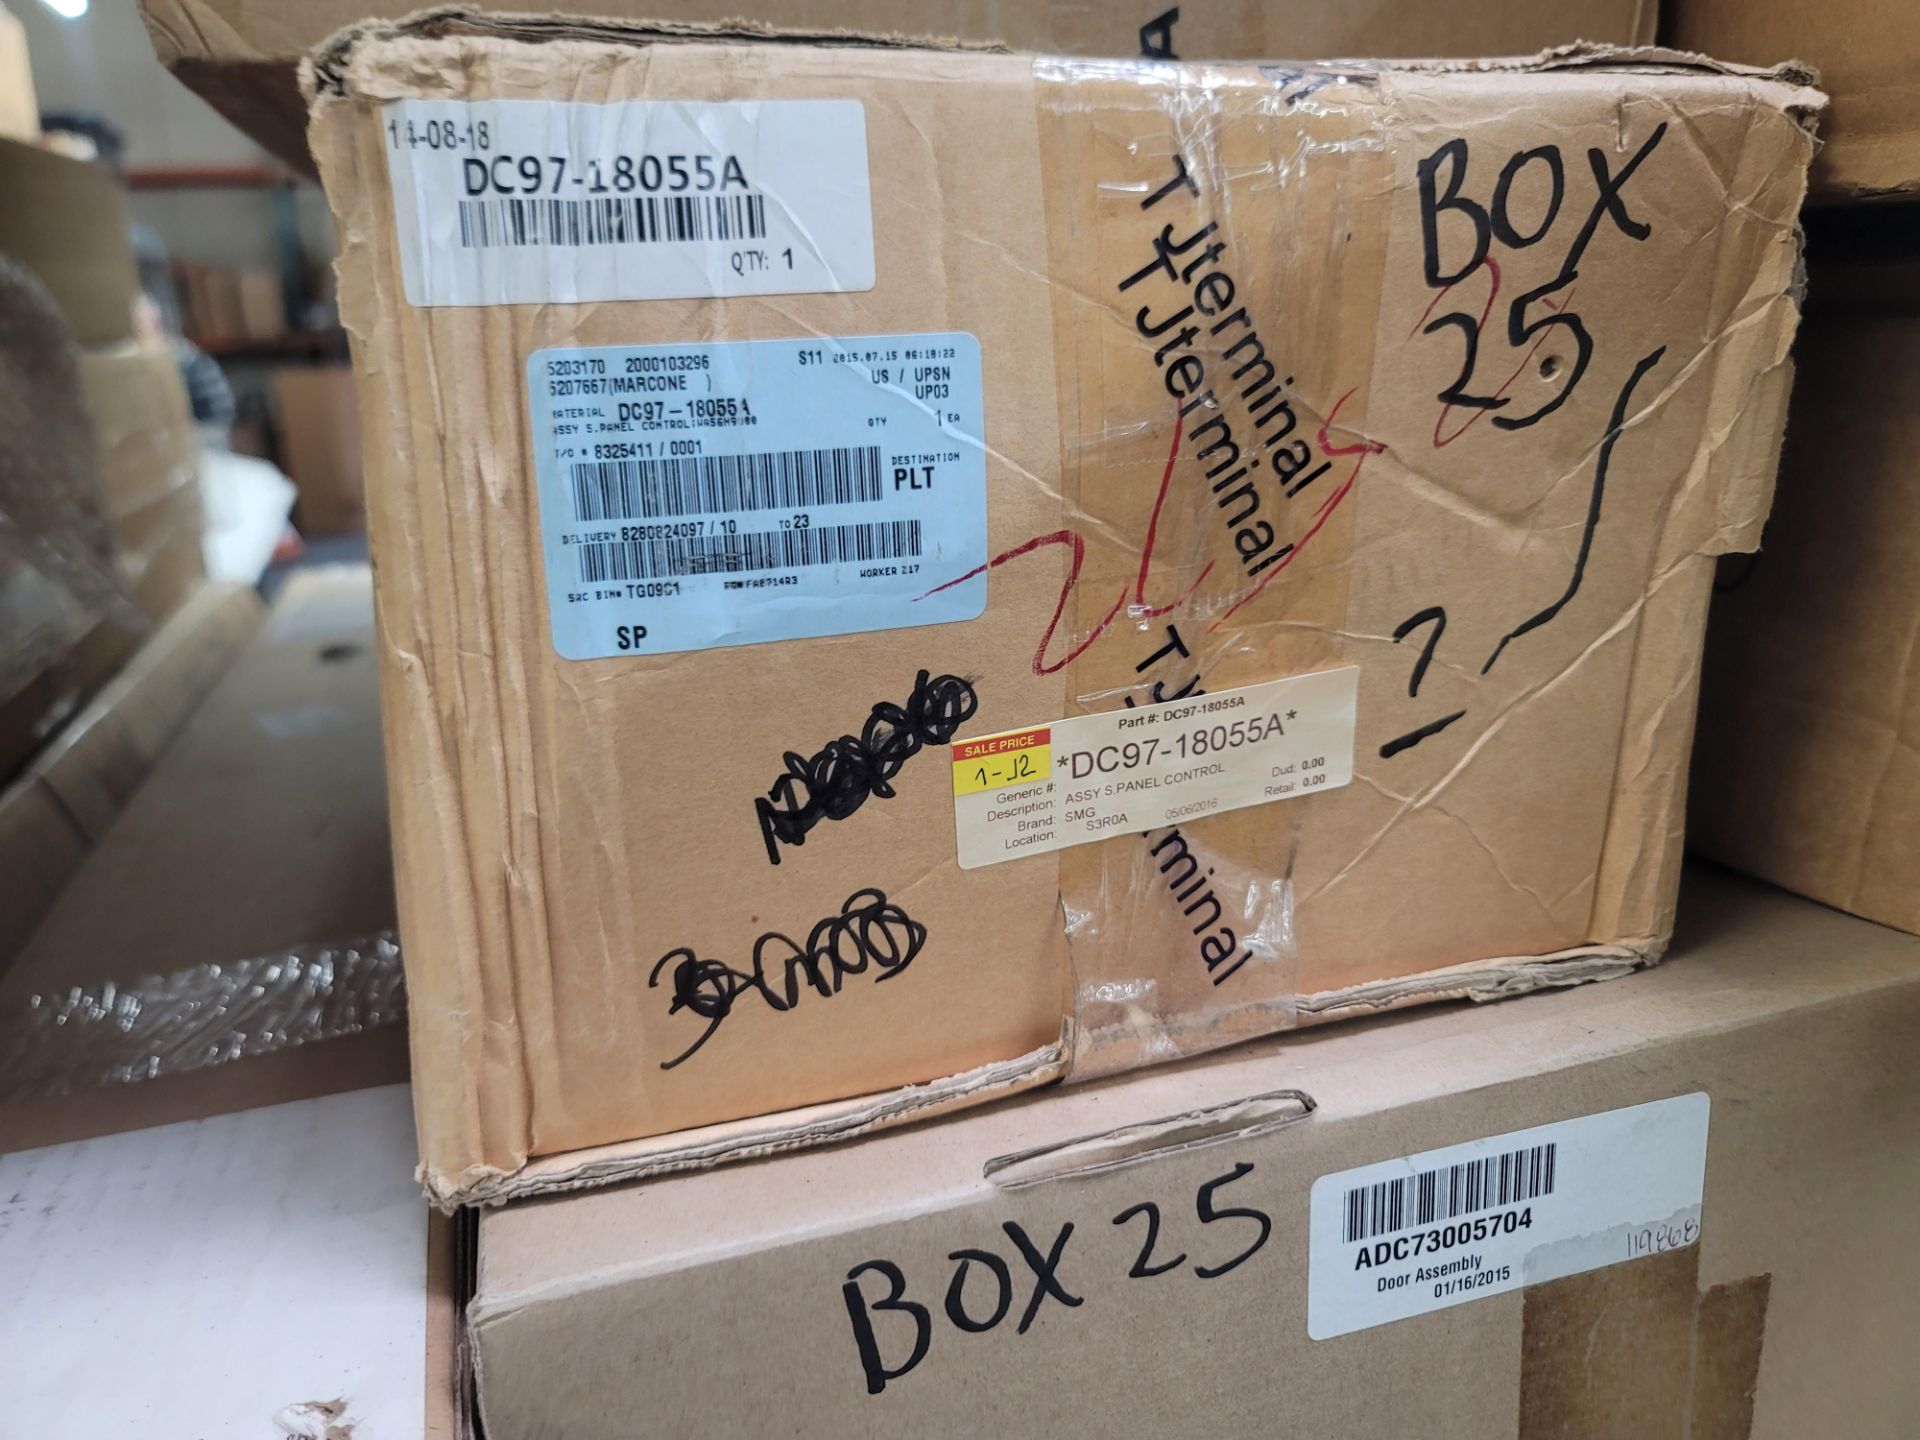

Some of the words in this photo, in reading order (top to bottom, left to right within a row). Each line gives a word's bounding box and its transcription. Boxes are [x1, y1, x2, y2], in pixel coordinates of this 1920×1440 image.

[463, 154, 749, 197] DC97-18055A
[1418, 122, 1667, 288] BOX
[731, 250, 769, 276] Q'TY:
[782, 248, 793, 270] 1
[799, 350, 823, 365] S11
[833, 351, 898, 363] 2015.07.15
[1424, 268, 1593, 430] 25
[625, 355, 709, 373] 2000103296
[871, 369, 889, 384] US
[914, 366, 951, 382] UPSN
[947, 413, 960, 423] EA
[594, 442, 653, 459] 8325411
[670, 440, 702, 456] 0001
[892, 453, 960, 466] DESTINATION
[894, 466, 935, 492] PLT
[562, 531, 616, 545] DELIVERY
[720, 520, 737, 534] 10
[793, 514, 810, 529] 23
[860, 567, 897, 577] WORKER
[617, 625, 648, 650] SP
[1118, 717, 1145, 730] Part
[1164, 696, 1245, 721] DC97-18055A
[964, 742, 996, 757] SALE
[1000, 735, 1036, 750] PRICE
[1272, 763, 1296, 778] Dud:
[1301, 756, 1325, 770] 0.00
[987, 800, 1057, 821] Description:
[1065, 787, 1101, 805] ASSY
[1164, 763, 1225, 785] CONTROL
[996, 787, 1043, 804] Generic
[1264, 782, 1296, 797] Retail:
[1303, 774, 1326, 787] 0.00
[1017, 815, 1056, 831] Brand:
[1065, 807, 1096, 822] SMG
[1005, 832, 1057, 849] Location:
[1354, 1207, 1533, 1271] ADC73005704
[843, 1220, 1084, 1394] BOX
[1112, 1162, 1272, 1279] 25
[1377, 1273, 1410, 1292] Door
[1415, 1254, 1482, 1283] Assembly
[1434, 1265, 1510, 1298] 01/16/2015
